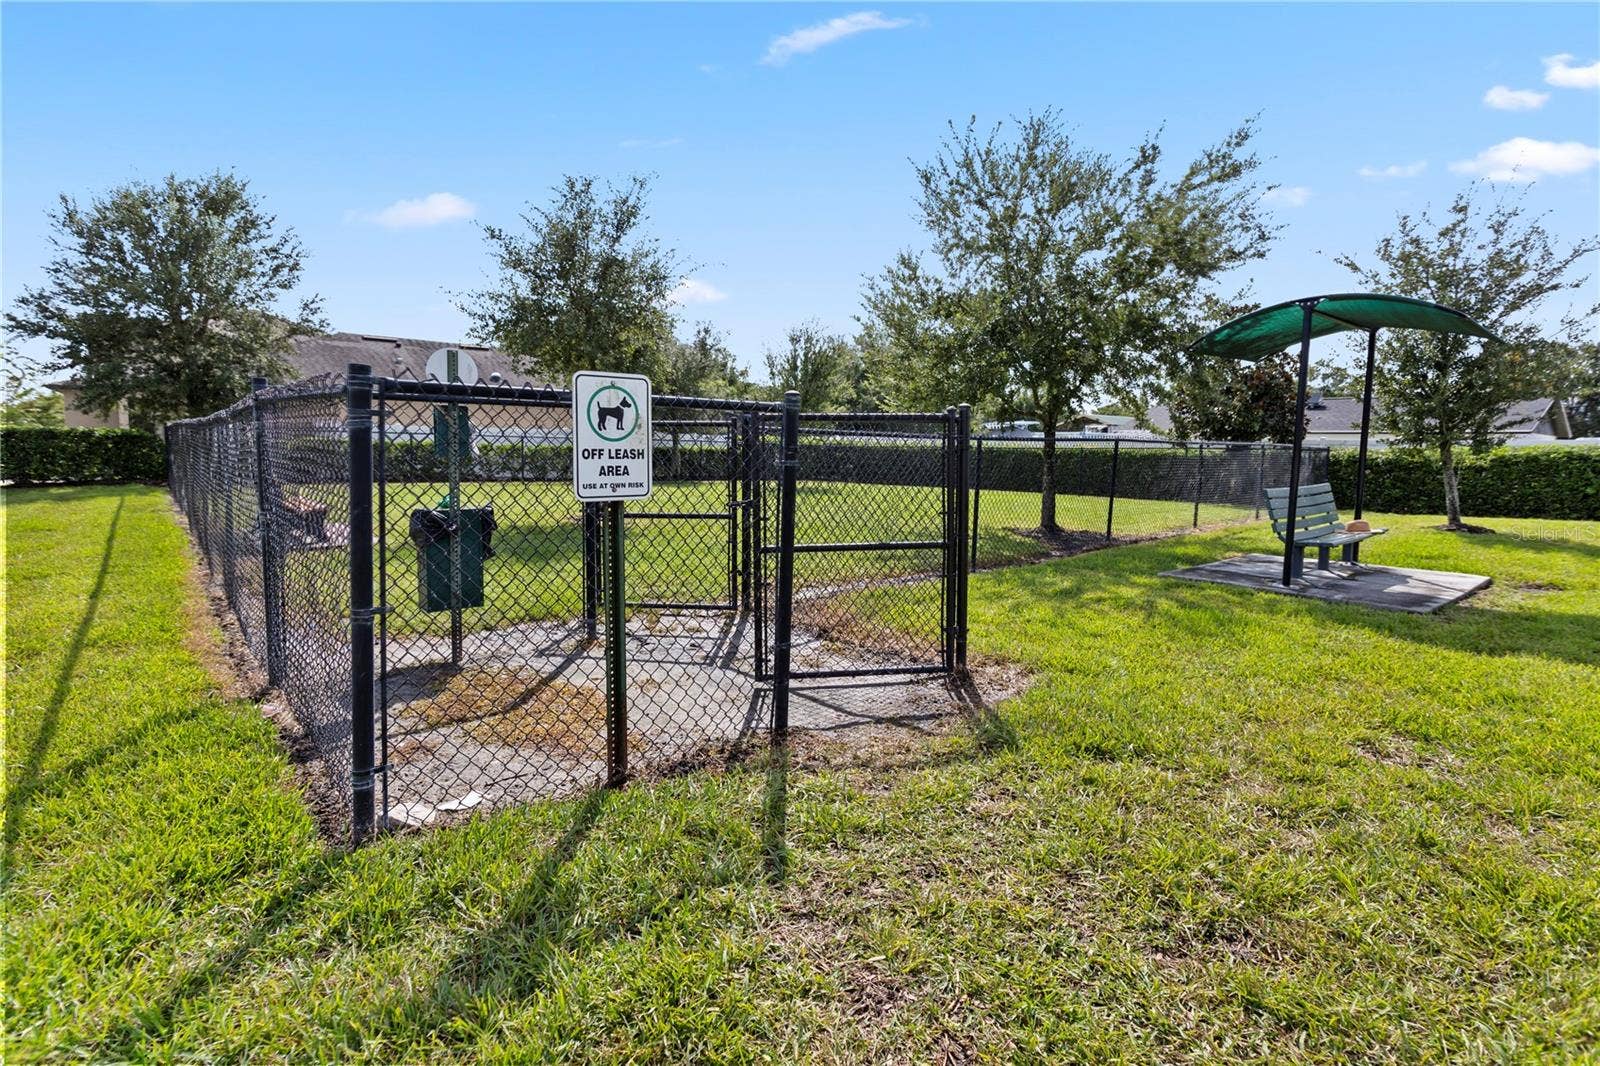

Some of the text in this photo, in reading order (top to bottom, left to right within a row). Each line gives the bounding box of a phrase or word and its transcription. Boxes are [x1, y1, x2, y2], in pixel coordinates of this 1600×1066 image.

[581, 448, 645, 460] OFF LEASH
[598, 465, 630, 477] AREA
